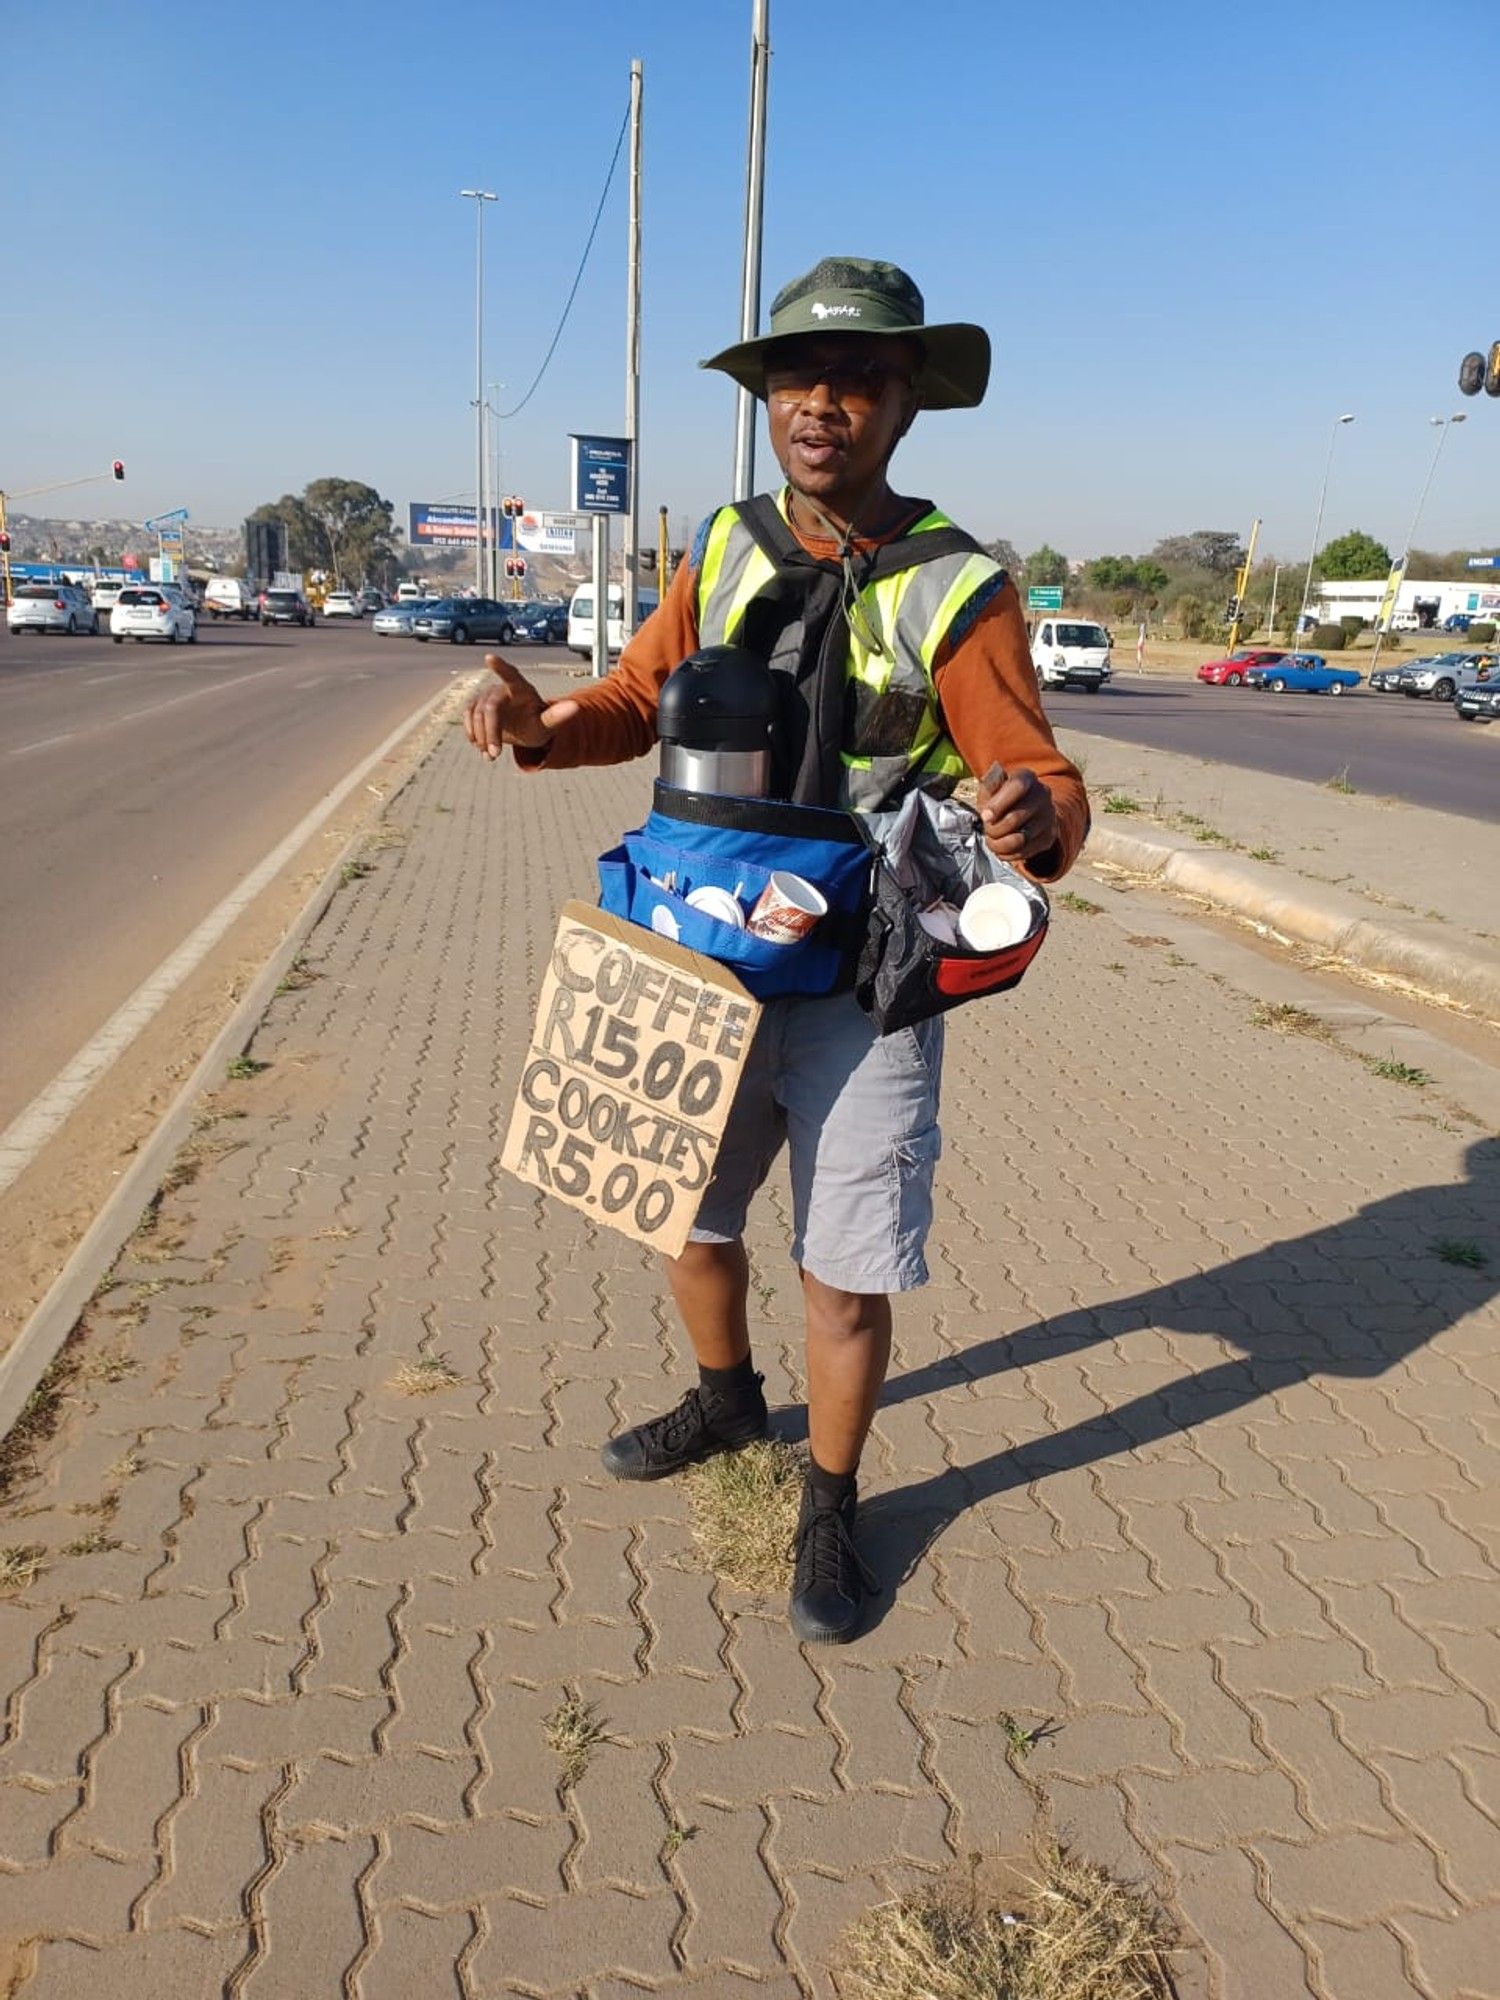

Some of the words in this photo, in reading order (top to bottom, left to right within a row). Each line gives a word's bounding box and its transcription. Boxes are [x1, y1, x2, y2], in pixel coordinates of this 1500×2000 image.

[544, 987, 722, 1117] R15.00
[553, 927, 750, 1061] COFFEE
[518, 1115, 675, 1233] R5.00
[522, 1059, 717, 1191] COOKIES
